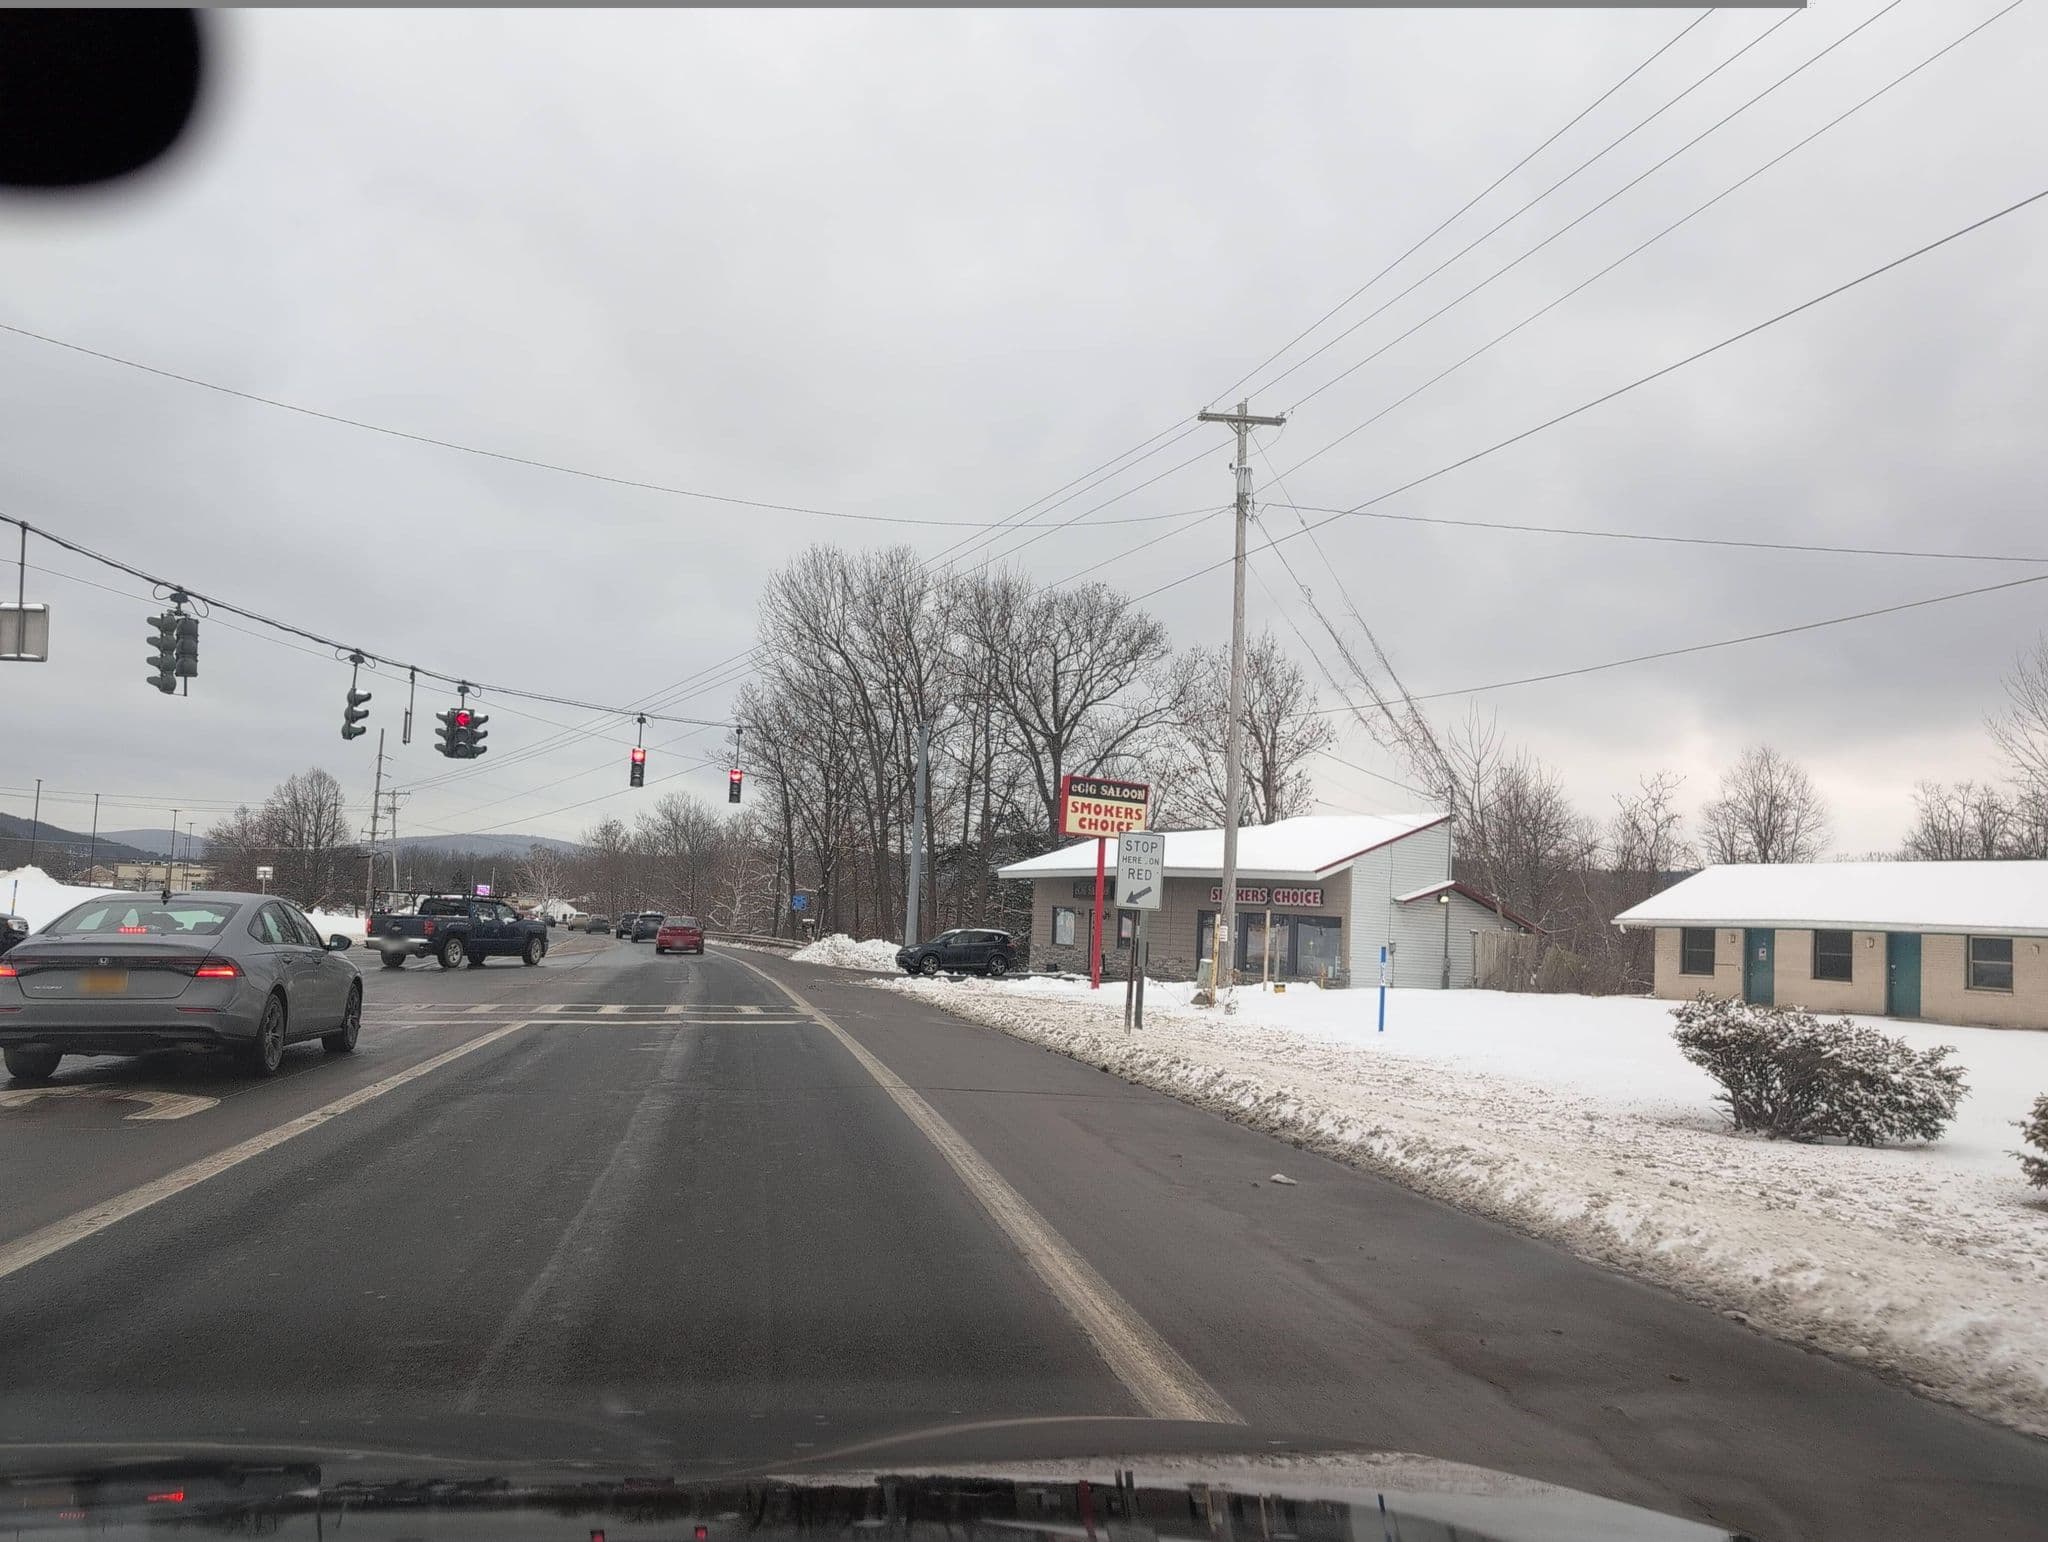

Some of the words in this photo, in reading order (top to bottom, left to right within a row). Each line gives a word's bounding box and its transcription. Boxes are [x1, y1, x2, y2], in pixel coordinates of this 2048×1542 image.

[1101, 786, 1145, 800] SALOON
[1070, 801, 1142, 820] SMOKERS
[1078, 817, 1134, 832] CHOICE
[1125, 840, 1158, 853] STOP
[1122, 856, 1142, 864] HERE
[1149, 857, 1159, 865] ON
[1128, 868, 1152, 881] RED
[1212, 888, 1266, 902] SKERS
[1274, 890, 1320, 904] CHOICE
